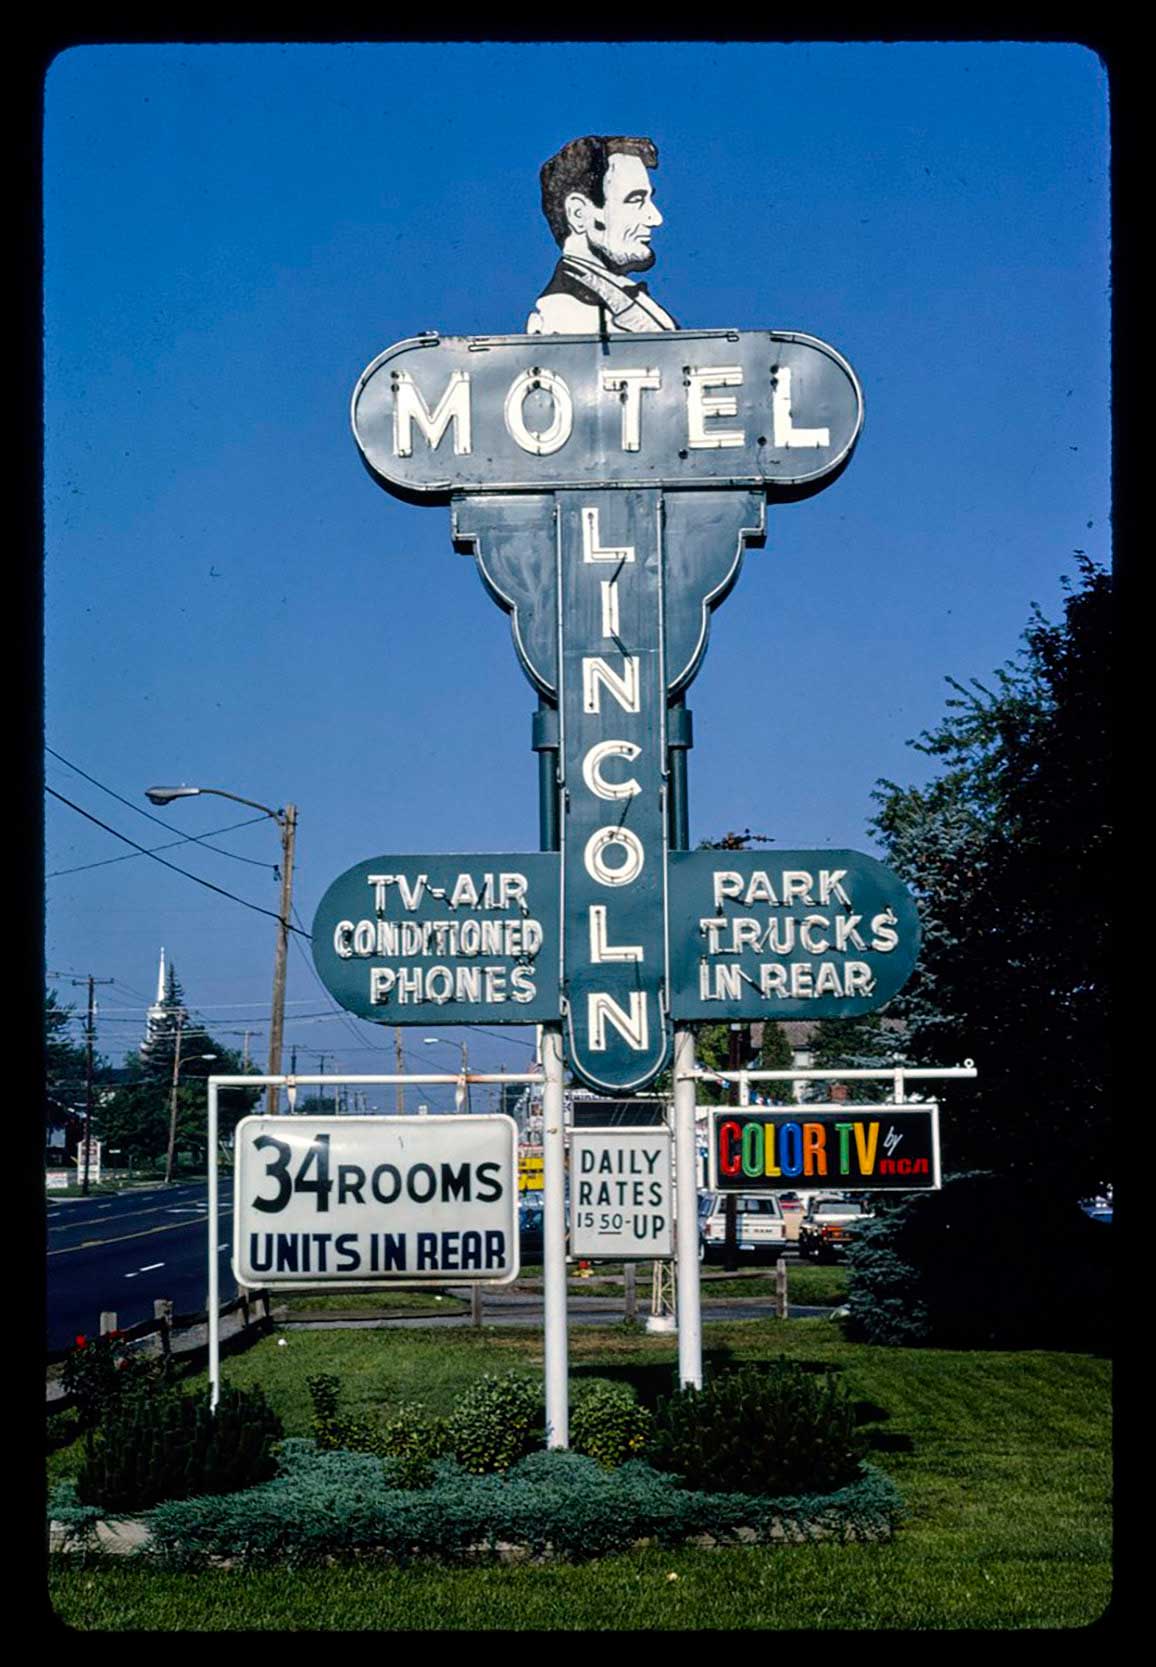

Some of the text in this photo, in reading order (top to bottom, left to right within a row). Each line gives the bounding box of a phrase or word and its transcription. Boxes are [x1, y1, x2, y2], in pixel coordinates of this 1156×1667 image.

[393, 366, 829, 455] MOTEL
[582, 507, 649, 1051] LINCOLN
[368, 872, 528, 911] TV-AIR
[713, 869, 850, 906] PARK
[333, 919, 542, 957] CONDITIONED
[700, 913, 898, 954] TRUCKS
[370, 964, 536, 1004] PHONES
[699, 961, 877, 1002] IN REAR
[581, 1149, 661, 1174] DAILY
[719, 1121, 828, 1177] COLOR
[834, 1121, 880, 1176] TV
[883, 1126, 903, 1156] by
[251, 1133, 334, 1213] 34
[338, 1162, 504, 1204] ROOMS
[579, 1181, 663, 1207] RATES
[250, 1230, 506, 1272] UNITS IN REAR
